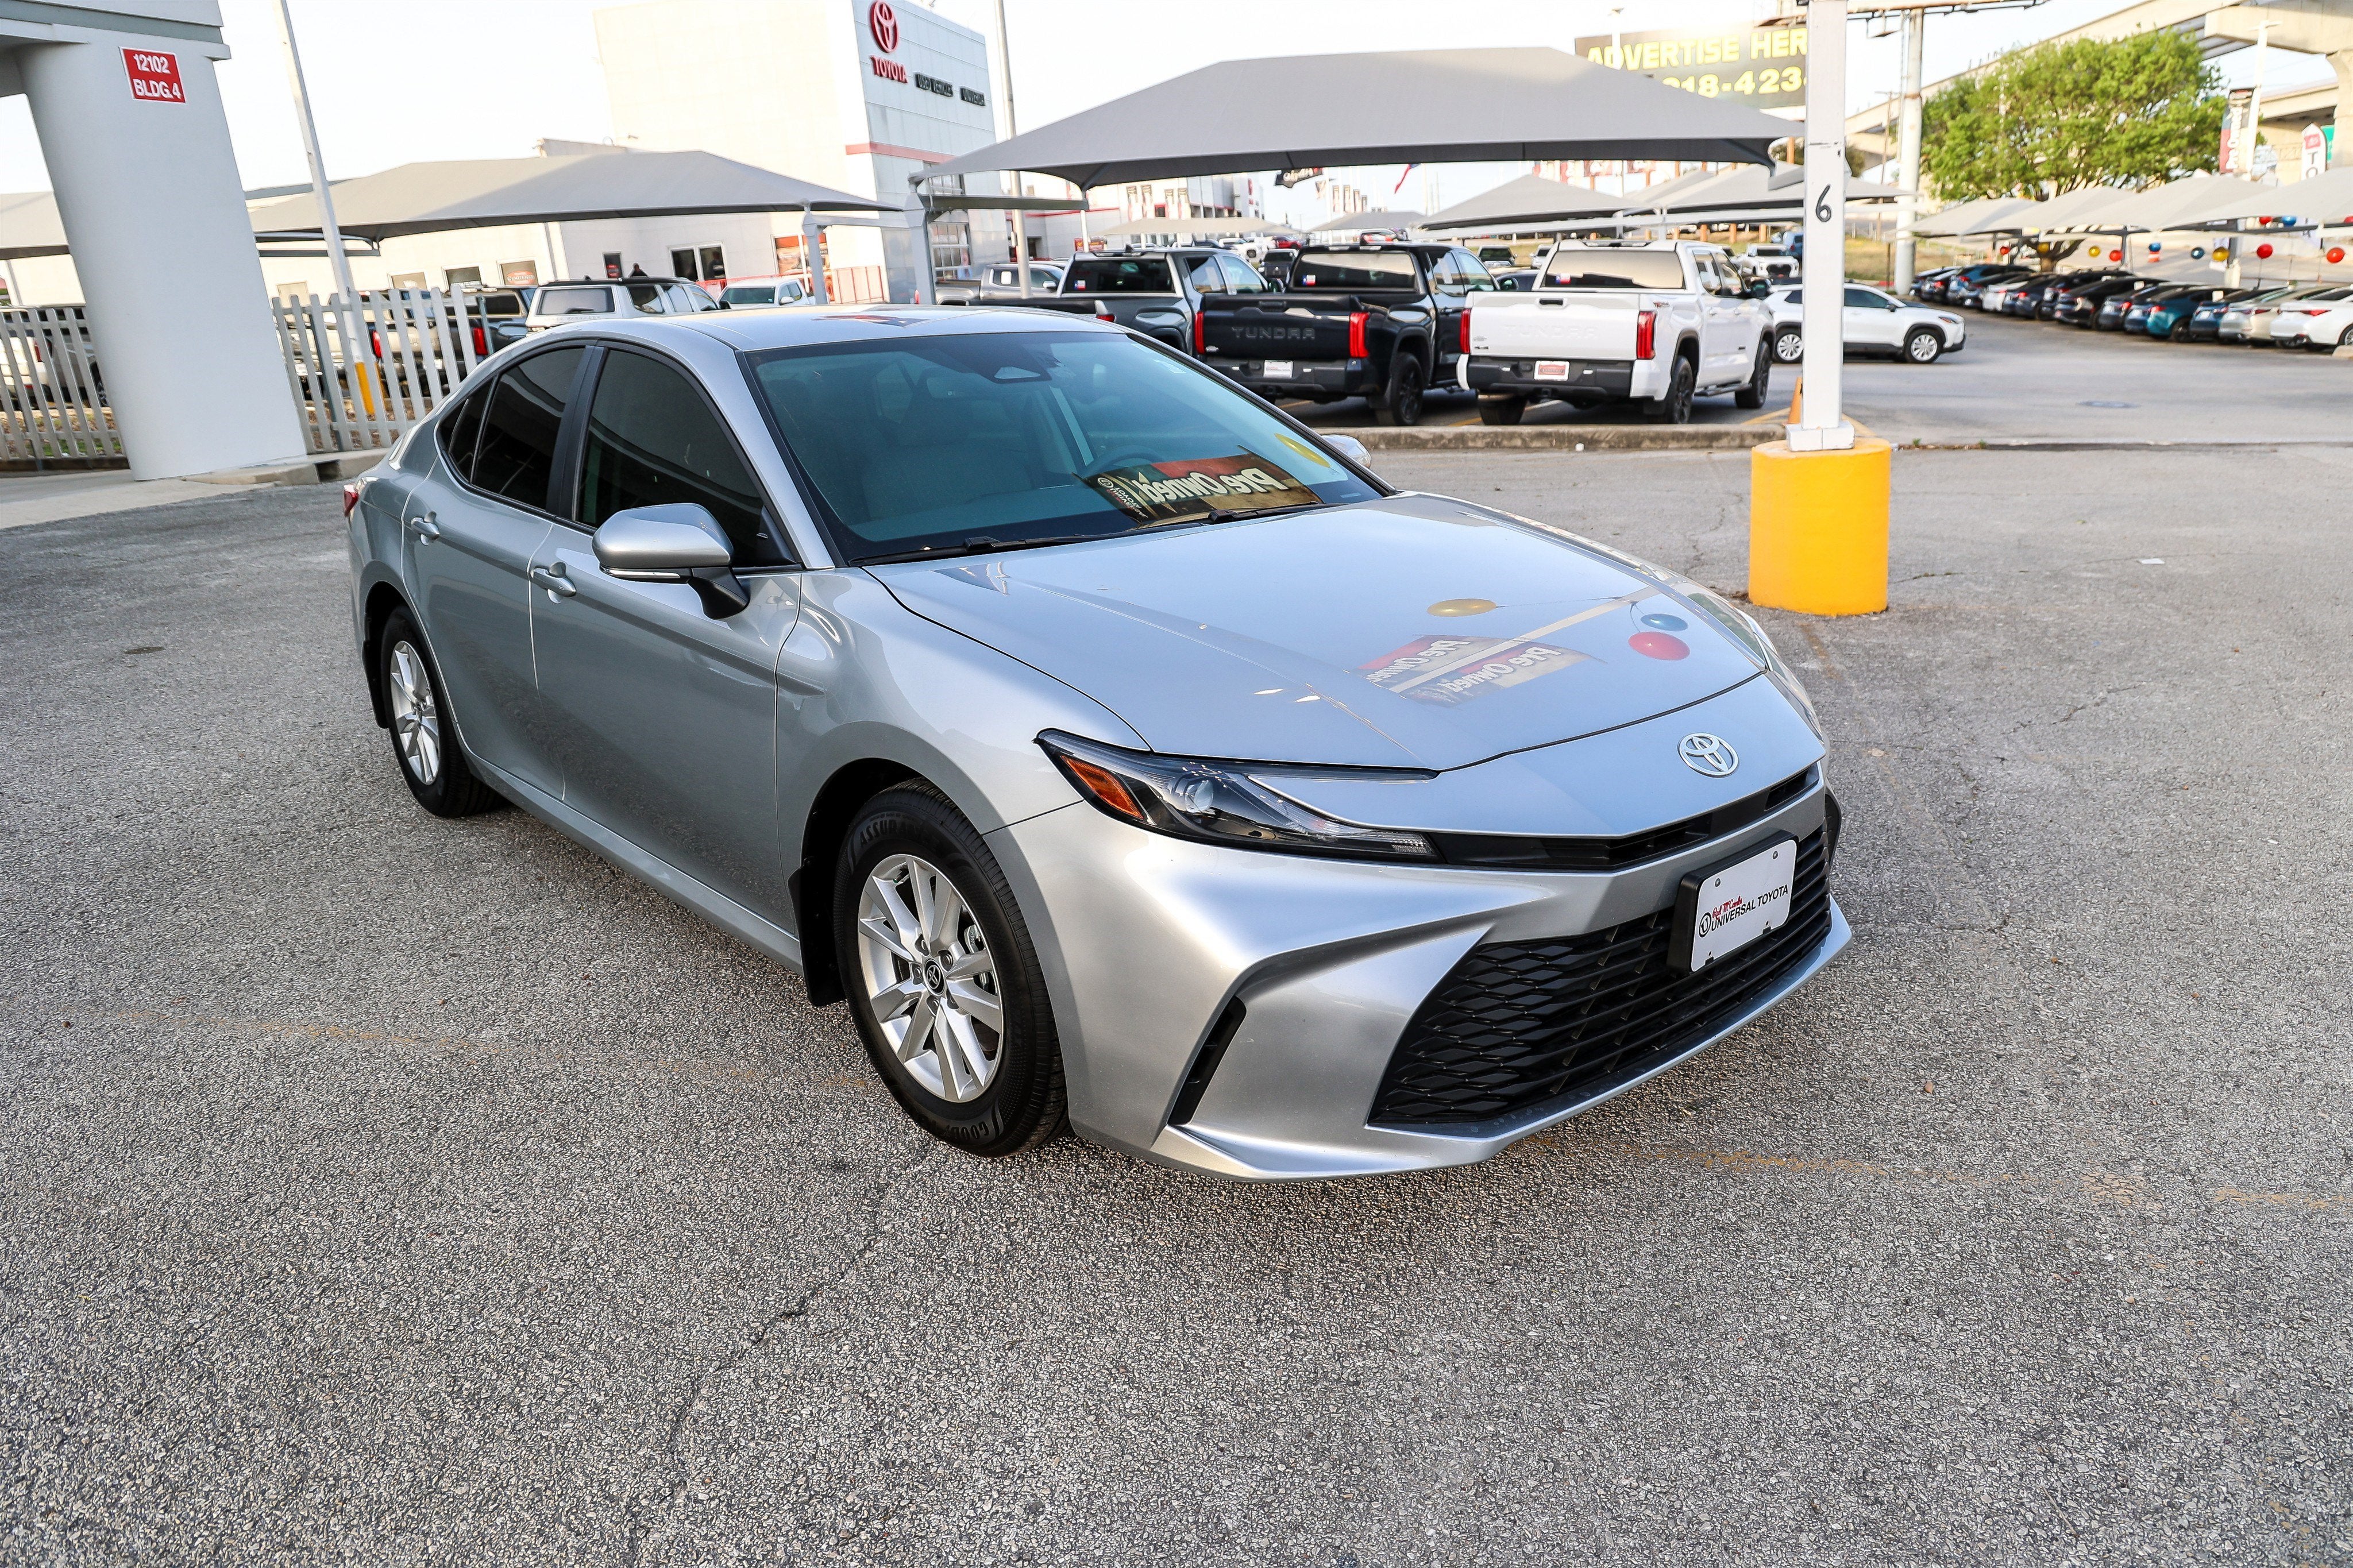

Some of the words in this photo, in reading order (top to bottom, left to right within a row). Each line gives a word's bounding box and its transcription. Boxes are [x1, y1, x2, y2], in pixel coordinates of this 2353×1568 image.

[1588, 34, 1739, 71] ADVERTISE
[1750, 27, 1807, 60] HER
[133, 53, 172, 75] 12102
[870, 55, 908, 84] TOYOTA
[1815, 185, 1831, 222] 6
[1232, 326, 1316, 340] TUNDRA
[1503, 323, 1599, 340] TUNDRA
[1711, 899, 1756, 932] UNIVERSAL
[1757, 884, 1788, 907] TOYOTA
